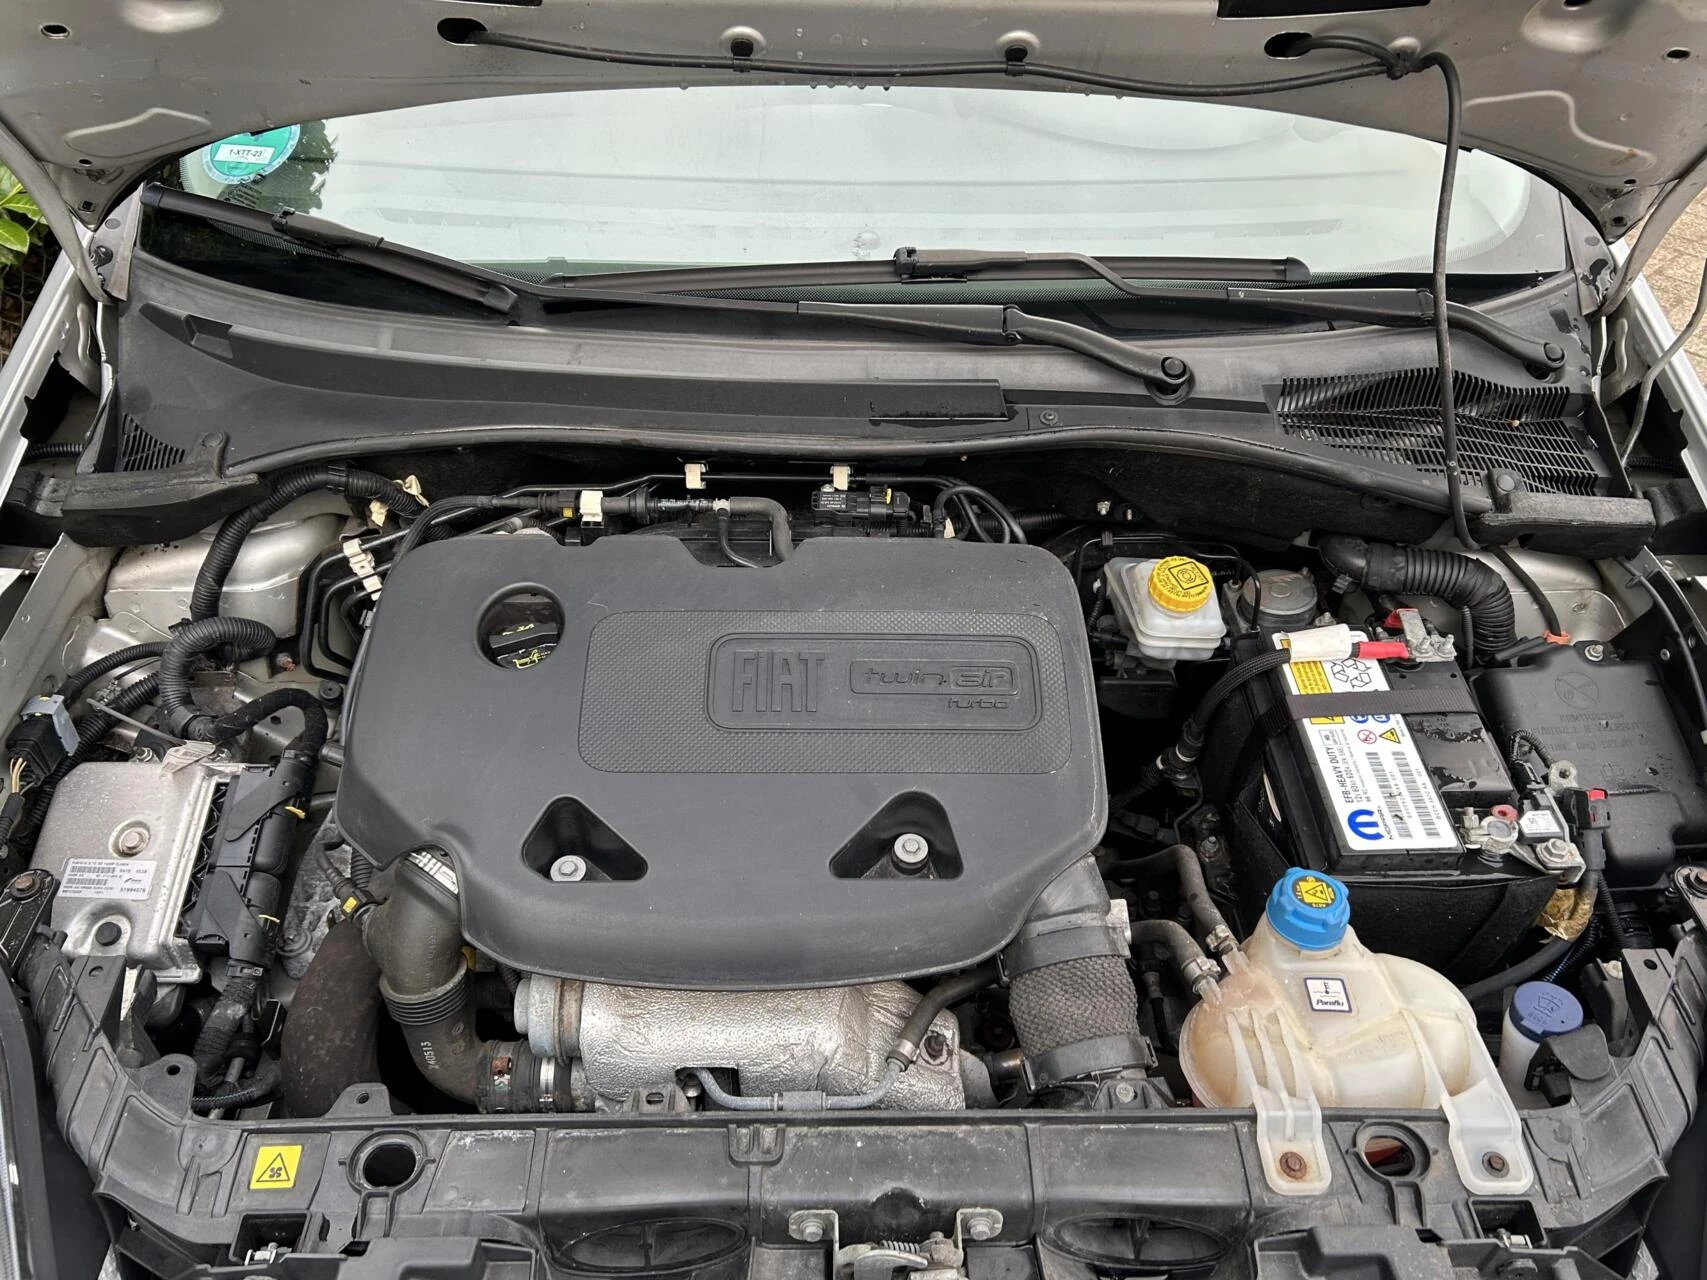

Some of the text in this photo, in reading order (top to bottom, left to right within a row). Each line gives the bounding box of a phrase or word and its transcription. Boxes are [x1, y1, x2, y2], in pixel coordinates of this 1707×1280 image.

[731, 650, 826, 712] FIAT
[1325, 746, 1339, 764] DUTY
[1333, 766, 1354, 803] EFB-HEAVY
[1378, 809, 1393, 840] MOPAR
[1316, 998, 1344, 1007] Paraflu
